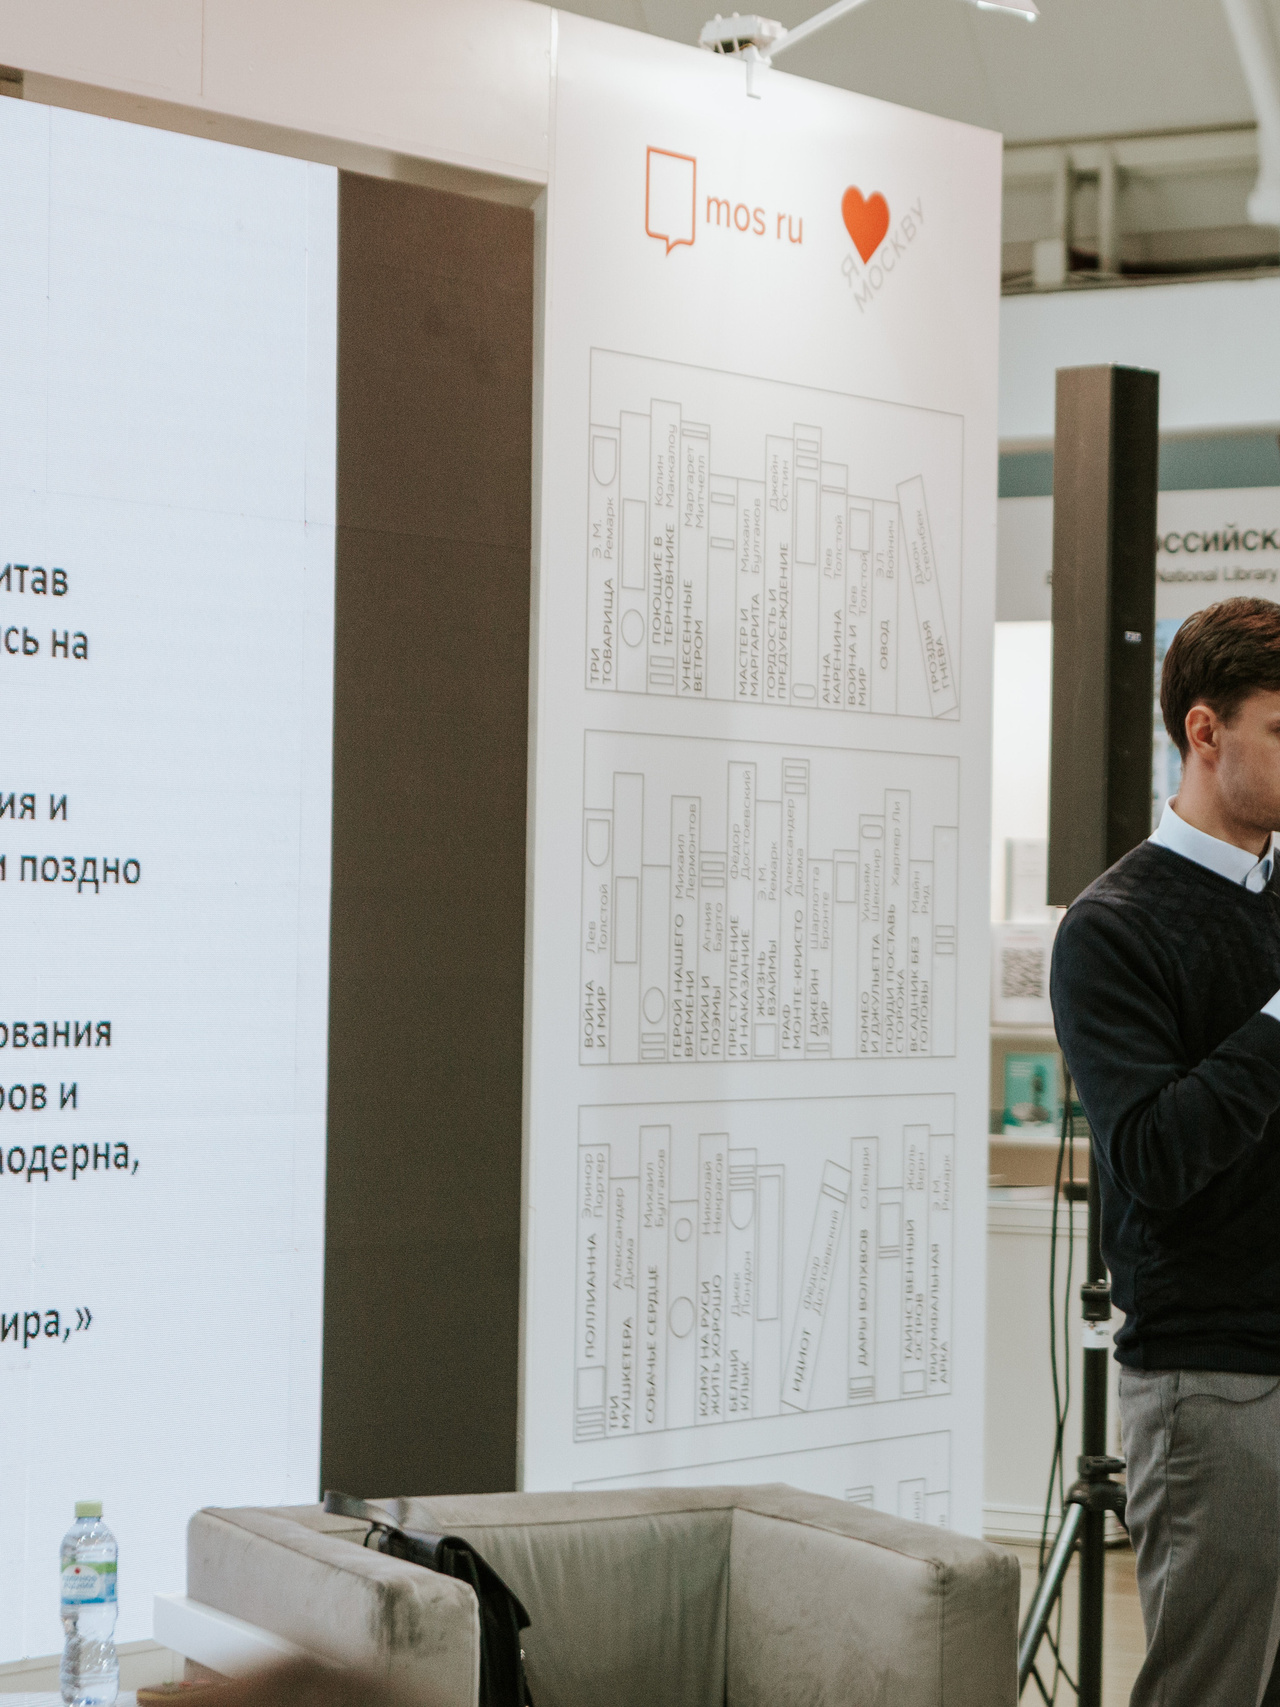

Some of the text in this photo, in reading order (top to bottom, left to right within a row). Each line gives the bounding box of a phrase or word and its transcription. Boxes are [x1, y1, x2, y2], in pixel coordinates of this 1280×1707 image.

[706, 195, 803, 245] mos ru
[852, 197, 926, 314] МОСКВУ
[654, 455, 664, 506] Колин
[666, 424, 677, 508] Маккалоу
[684, 445, 696, 527] Маргарет
[695, 455, 706, 529] Митчелл
[769, 454, 780, 511] Джейн
[780, 460, 789, 512] Остин
[592, 519, 602, 559] Э. М.
[604, 497, 616, 560] Ремарк
[740, 508, 750, 573] Михаил
[751, 498, 762, 574] Булгаков
[833, 515, 844, 579] Толстой
[886, 520, 895, 579] Войнич
[652, 536, 663, 644] ПОЮЩИЕ В
[664, 523, 675, 645] ТЕРНОВНИКЕ
[824, 548, 832, 579] Лев
[859, 552, 869, 617] Толстой
[911, 540, 925, 585] Джон
[1222, 565, 1278, 584] Library
[602, 578, 615, 685] ТОВАРИЩА
[777, 542, 789, 699] ПРЕДУБЕЖДЕНИЕ
[849, 586, 858, 616] Лев
[0, 624, 89, 660] сь на
[590, 648, 600, 683] ТРИ
[682, 579, 692, 692] УНЕСЕННЫЕ
[694, 620, 703, 692] ВЕТРОМ
[739, 608, 749, 696] МАСТЕР И
[750, 593, 760, 697] МАРГАРИТА
[766, 588, 778, 698] ГОРДОСТЬ И
[833, 609, 843, 704] КАРЕНИНА
[847, 624, 857, 706] ВОЙНА И
[880, 620, 890, 670] ОВОД
[922, 620, 941, 693] ГРОЗДЬЯ
[934, 636, 950, 689] ГНЕВА
[822, 653, 831, 704] АННА
[858, 667, 867, 707] МИР
[49, 793, 68, 821] и
[20, 854, 141, 894] поздно
[675, 834, 685, 900] Михаил
[686, 804, 697, 901] Лермонтов
[769, 842, 778, 901] Ремарк
[785, 798, 796, 896] Александер
[794, 848, 805, 897] Дюма
[892, 801, 901, 886] Харпер Ли
[758, 863, 767, 901] Э. М.
[810, 866, 821, 950] Шарлотта
[861, 863, 871, 922] Уильям
[872, 848, 883, 922] Шекспир
[911, 870, 920, 914] Майн
[921, 884, 931, 914] Рид
[586, 921, 596, 954] Лев
[597, 884, 608, 952] Толстой
[713, 902, 724, 952] Барто
[821, 891, 830, 950] Бронте
[672, 914, 684, 1057] ГЕРОЙ НАШЕГО
[728, 915, 739, 1057] ПРЕСТУПЛЕНИЕ
[739, 929, 750, 1056] И НАКАЗАНИЕ
[756, 951, 765, 1017] ЖИЗНЬ
[766, 940, 777, 1017] ВЗАЙМЫ
[793, 910, 803, 1049] МОНТЕ-КРИСТО
[809, 968, 820, 1037] ДЖЕЙН
[871, 933, 882, 1053] И ДЖУЛЬЕТТА
[885, 904, 896, 1053] ПОЙДИ ПОСТАВЬ
[896, 969, 905, 1053] СТОРОЖА
[910, 936, 920, 1052] ВСАДНИК БЕЗ
[583, 980, 595, 1048] ВОЙНА
[597, 986, 607, 1048] И МИР
[685, 970, 695, 1057] ВРЕМЕНИ
[700, 975, 710, 1056] СТИХИ И
[711, 985, 721, 1055] ПОЭМЫ
[782, 1004, 791, 1050] ГРАФ
[819, 1001, 829, 1036] ЭЙР
[861, 991, 869, 1053] РОМЕО
[920, 980, 929, 1052] ГОЛОВЫ
[0, 1081, 78, 1111] ов и
[0, 1141, 139, 1182] одерна,
[582, 1153, 594, 1219] Элинор
[593, 1152, 605, 1218] Портер
[655, 1149, 666, 1228] Булгаков
[712, 1152, 724, 1234] Некрасов
[906, 1144, 916, 1191] Жюль
[916, 1151, 926, 1191] Верн
[932, 1175, 941, 1211] Э. М.
[941, 1154, 951, 1210] Ремарк
[644, 1162, 655, 1228] Михаил
[700, 1161, 712, 1235] Николай
[612, 1187, 624, 1290] Александер
[623, 1238, 635, 1290] Дюма
[585, 1233, 597, 1359] ПОЛЛИАННА
[730, 1272, 742, 1316] Джек
[741, 1251, 752, 1315] Лондон
[857, 1228, 869, 1367] ДАРЫ ВОЛХВОВ
[903, 1219, 916, 1362] ТАИНСТВЕННЫЙ
[928, 1243, 940, 1385] ТРИУМФАЛЬНАЯ
[621, 1316, 633, 1430] МУШКЕТЕРА
[645, 1264, 659, 1424] СОБАЧЬЕ СЕРДЦЕ
[699, 1280, 710, 1417] КОМУ НА РУСИ
[711, 1274, 722, 1416] ЖИТЬ ХОРОШО
[792, 1327, 812, 1393] ИДИОТ
[938, 1341, 948, 1384] АРКА
[609, 1395, 619, 1431] ТРИ
[727, 1348, 740, 1412] БЕЛЫЙ
[740, 1360, 750, 1411] КЛЫК
